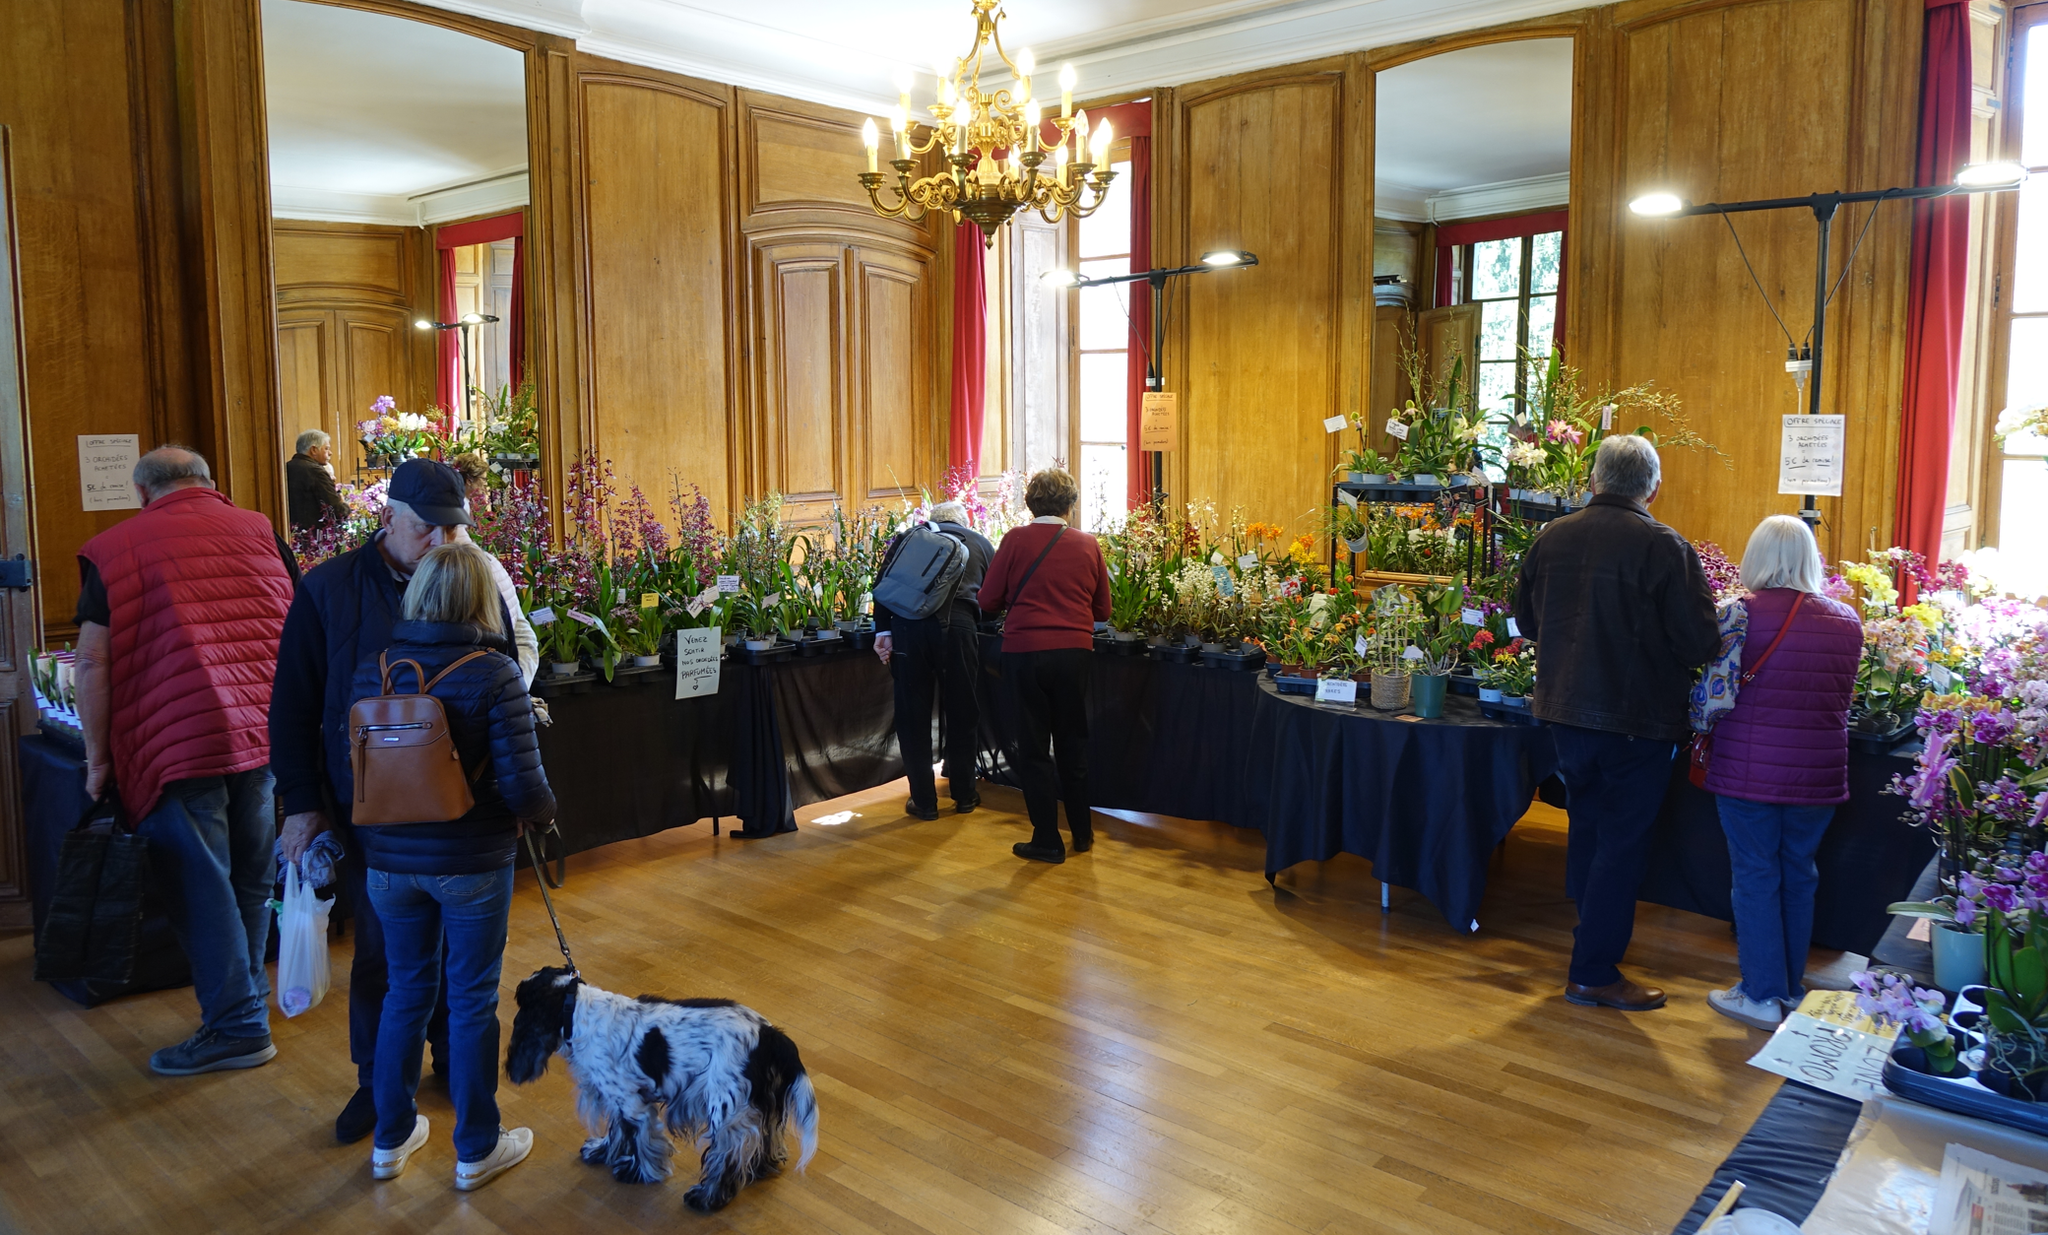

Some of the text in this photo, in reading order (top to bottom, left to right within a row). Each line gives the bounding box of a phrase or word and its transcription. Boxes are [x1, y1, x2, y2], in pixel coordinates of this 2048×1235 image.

[1786, 417, 1810, 426] OFFRE
[1787, 434, 1794, 442] 3
[84, 456, 91, 464] 3
[684, 634, 708, 645] VENEZ
[680, 665, 717, 680] PARFUMÉES
[1799, 1027, 1853, 1082] PROMO
